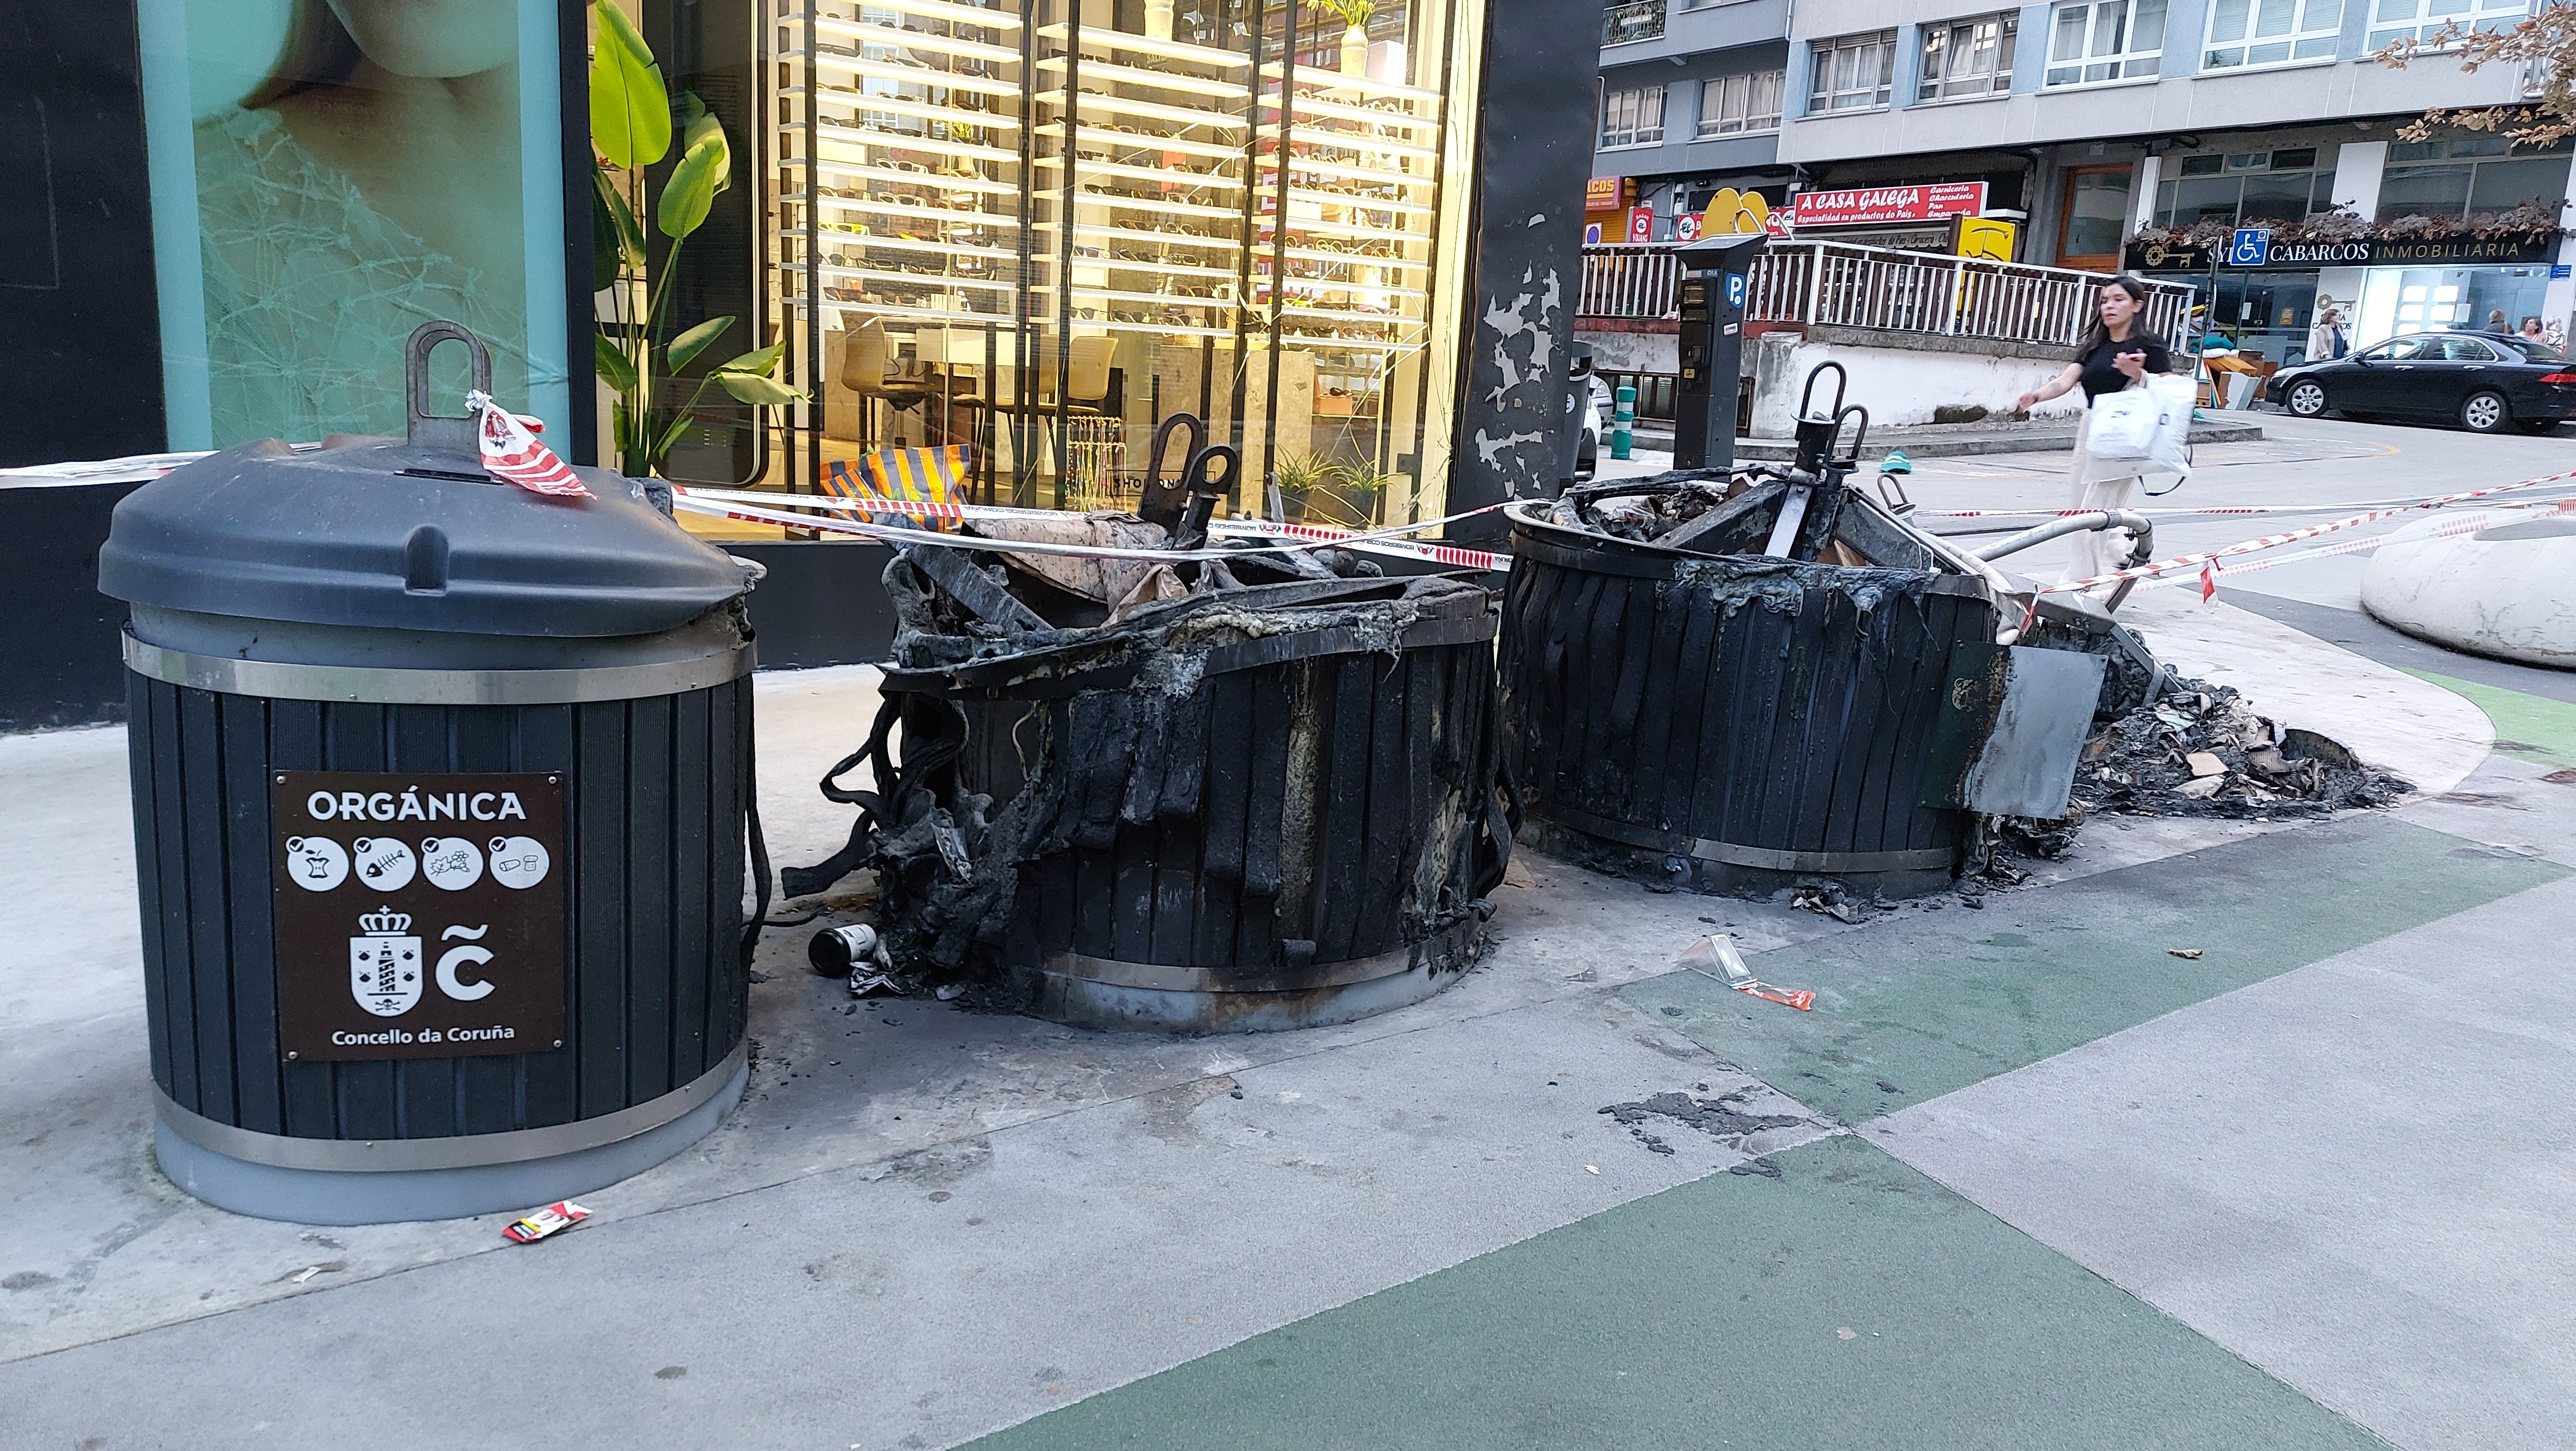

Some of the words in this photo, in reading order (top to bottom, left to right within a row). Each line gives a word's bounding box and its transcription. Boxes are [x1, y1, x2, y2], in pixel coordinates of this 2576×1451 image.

[1801, 195, 1812, 210] A
[1816, 192, 1855, 210] CASA
[1859, 189, 1919, 210] GALEGA
[1797, 212, 1840, 223] Especialidad
[1850, 211, 1885, 221] productos
[1886, 210, 1895, 218] do
[2270, 244, 2369, 261] CABARCOS
[2375, 242, 2519, 259] INMOBILIARIA
[1114, 478, 1145, 488] SHO
[1381, 541, 1414, 549] BOMBEIROS
[307, 785, 526, 821] ORGÁNICA
[331, 1029, 413, 1047] Concello
[418, 1028, 442, 1044] da
[447, 1025, 515, 1041] Coruña
